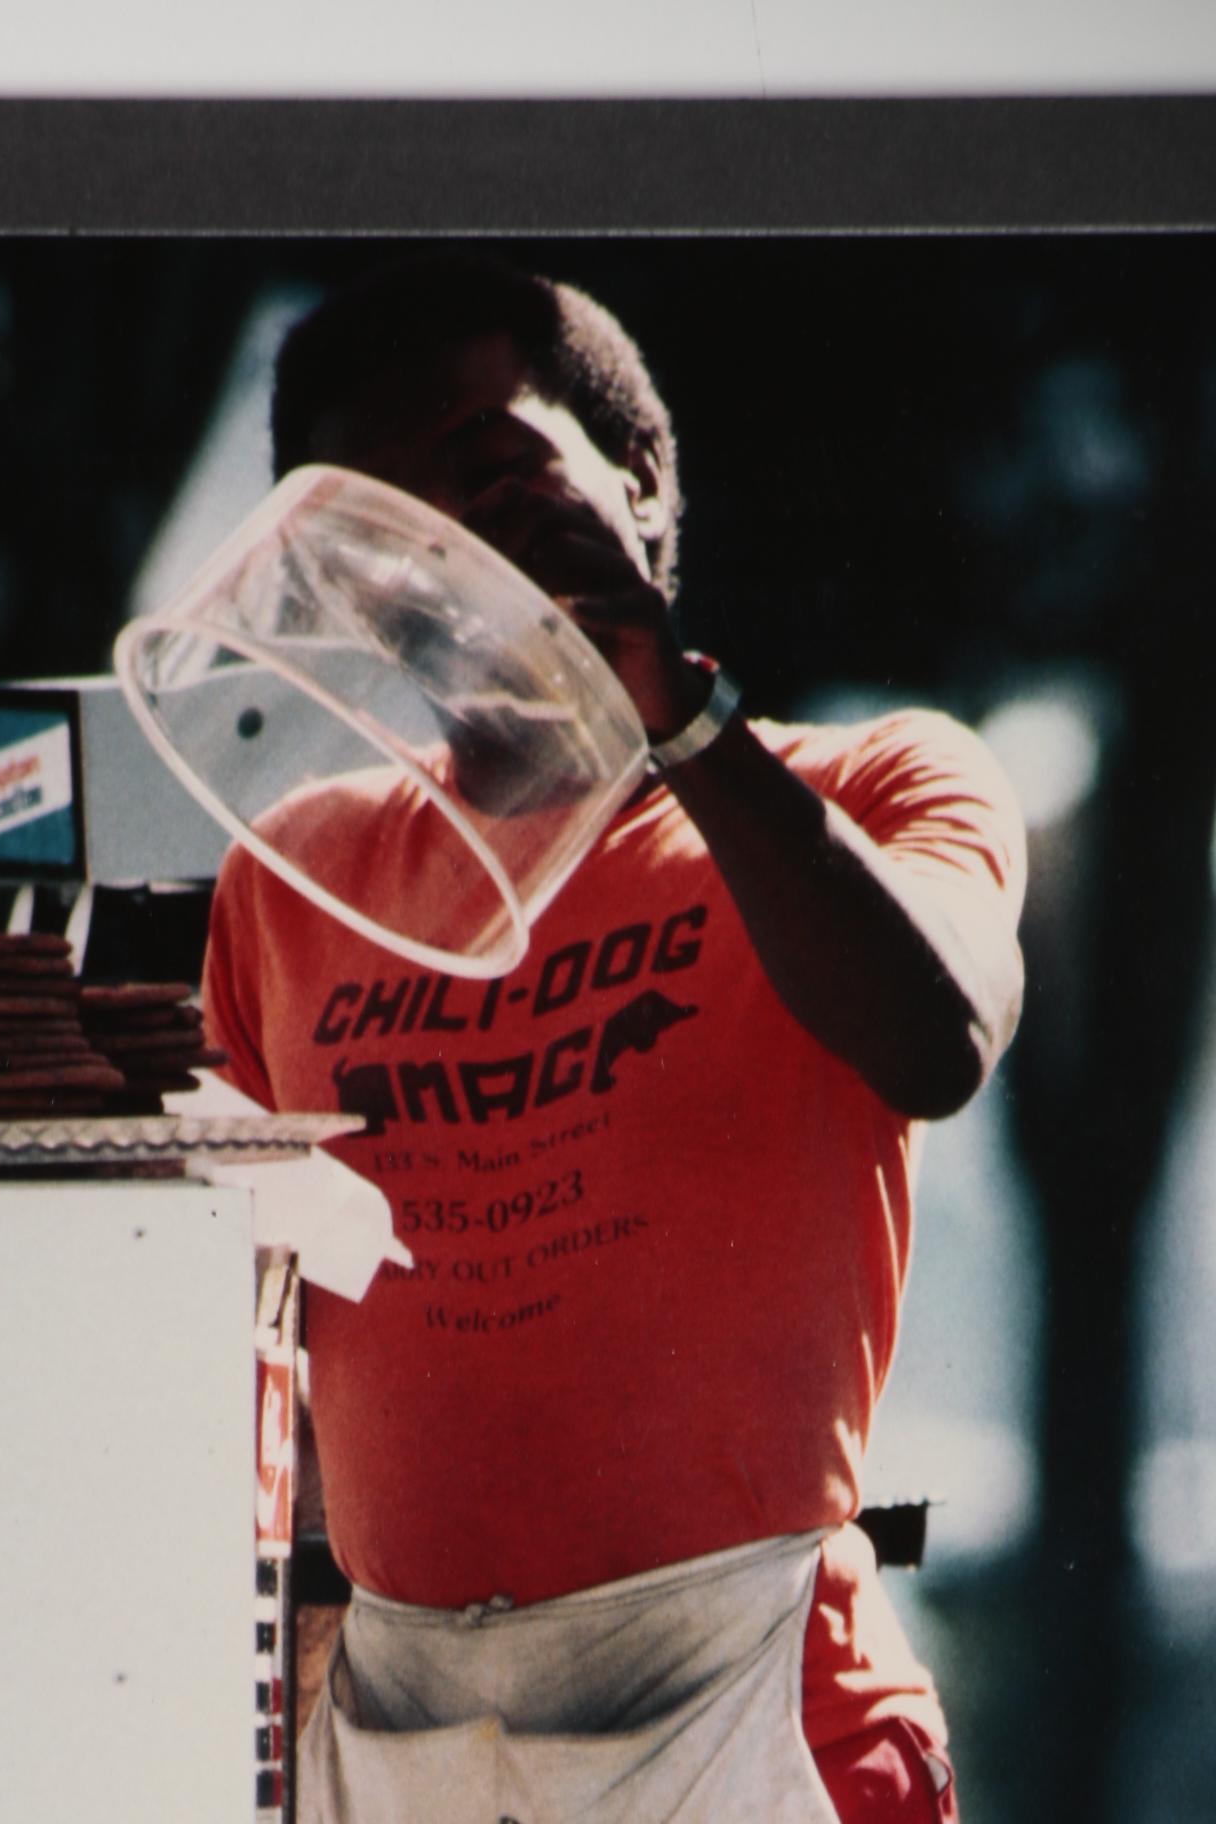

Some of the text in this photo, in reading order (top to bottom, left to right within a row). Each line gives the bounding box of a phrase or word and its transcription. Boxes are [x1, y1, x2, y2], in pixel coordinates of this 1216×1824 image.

[457, 1150, 521, 1172] Main
[530, 1111, 611, 1156] Street
[401, 1168, 586, 1235] 535-0923
[451, 1255, 513, 1285] OUT
[526, 1212, 651, 1268] ORDERS
[424, 1293, 563, 1333] Welcome
